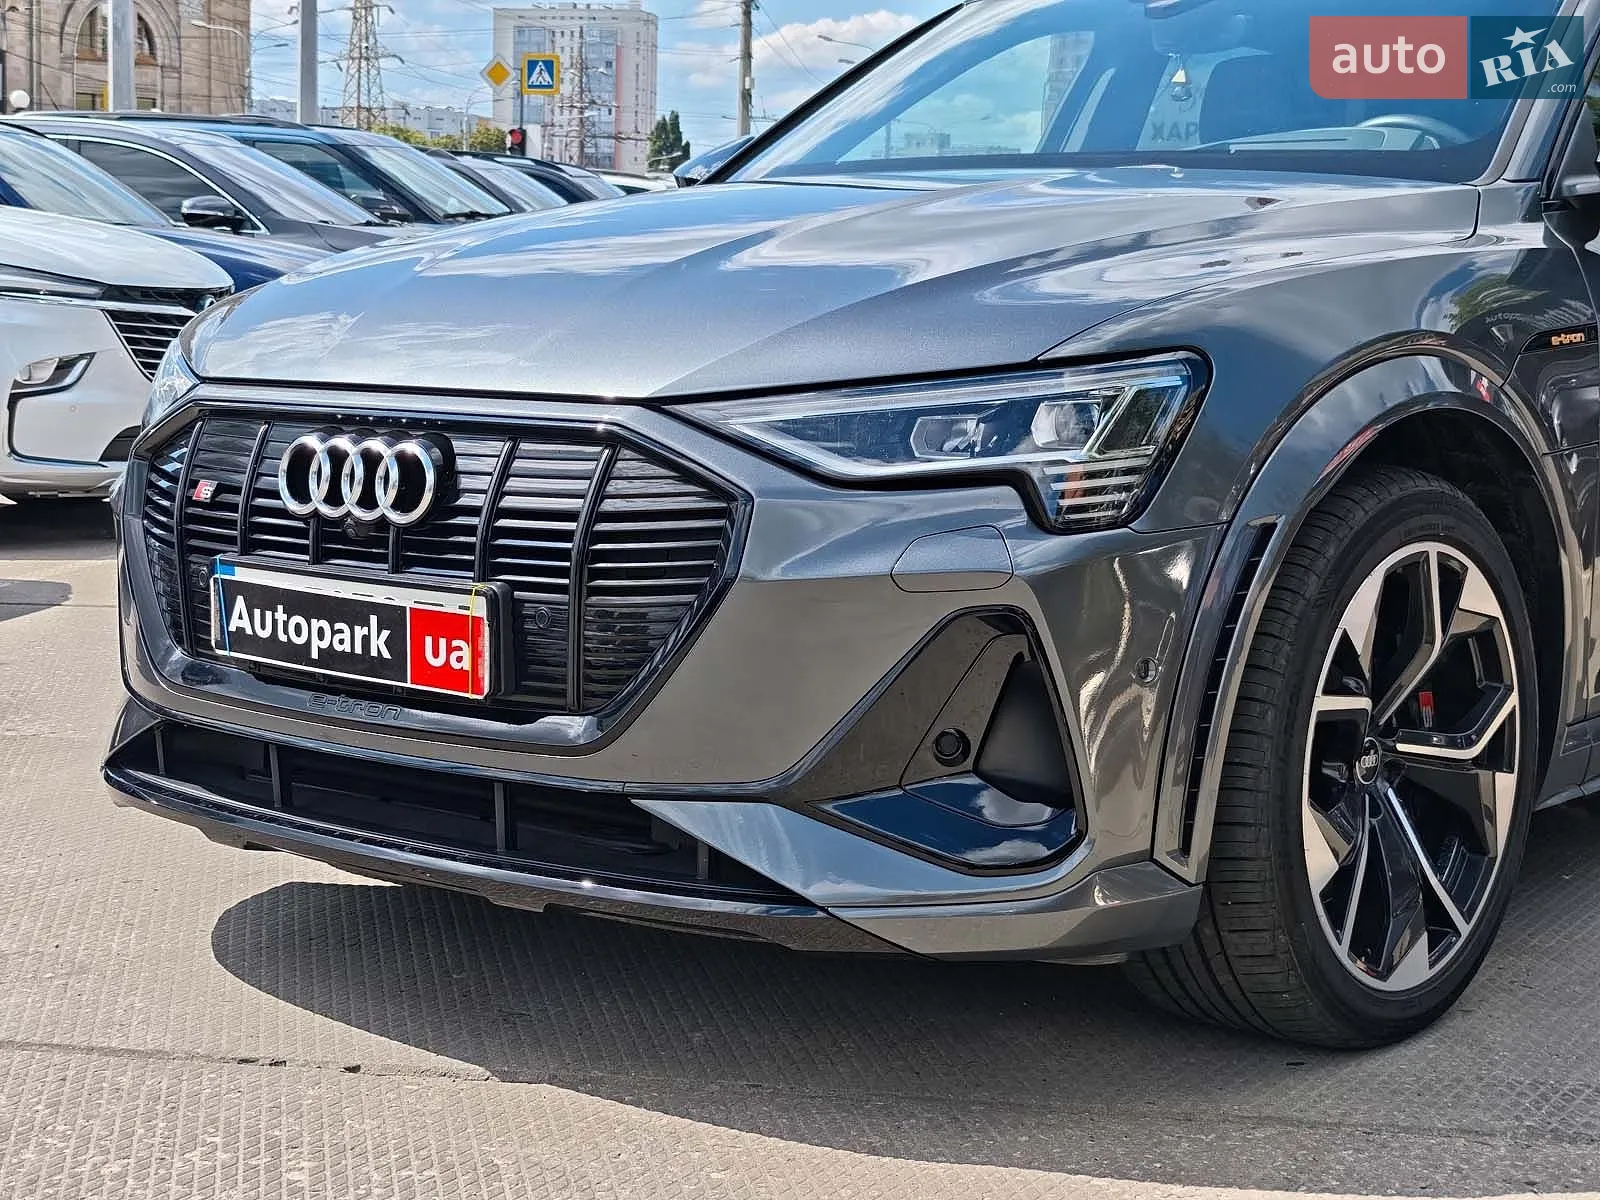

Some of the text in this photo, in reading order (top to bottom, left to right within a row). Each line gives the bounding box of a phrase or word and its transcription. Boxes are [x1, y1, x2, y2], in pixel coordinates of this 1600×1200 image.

[1551, 332, 1585, 346] e-tron
[228, 595, 392, 659] Autopark
[424, 634, 470, 671] ua
[308, 693, 402, 721] e-tron
